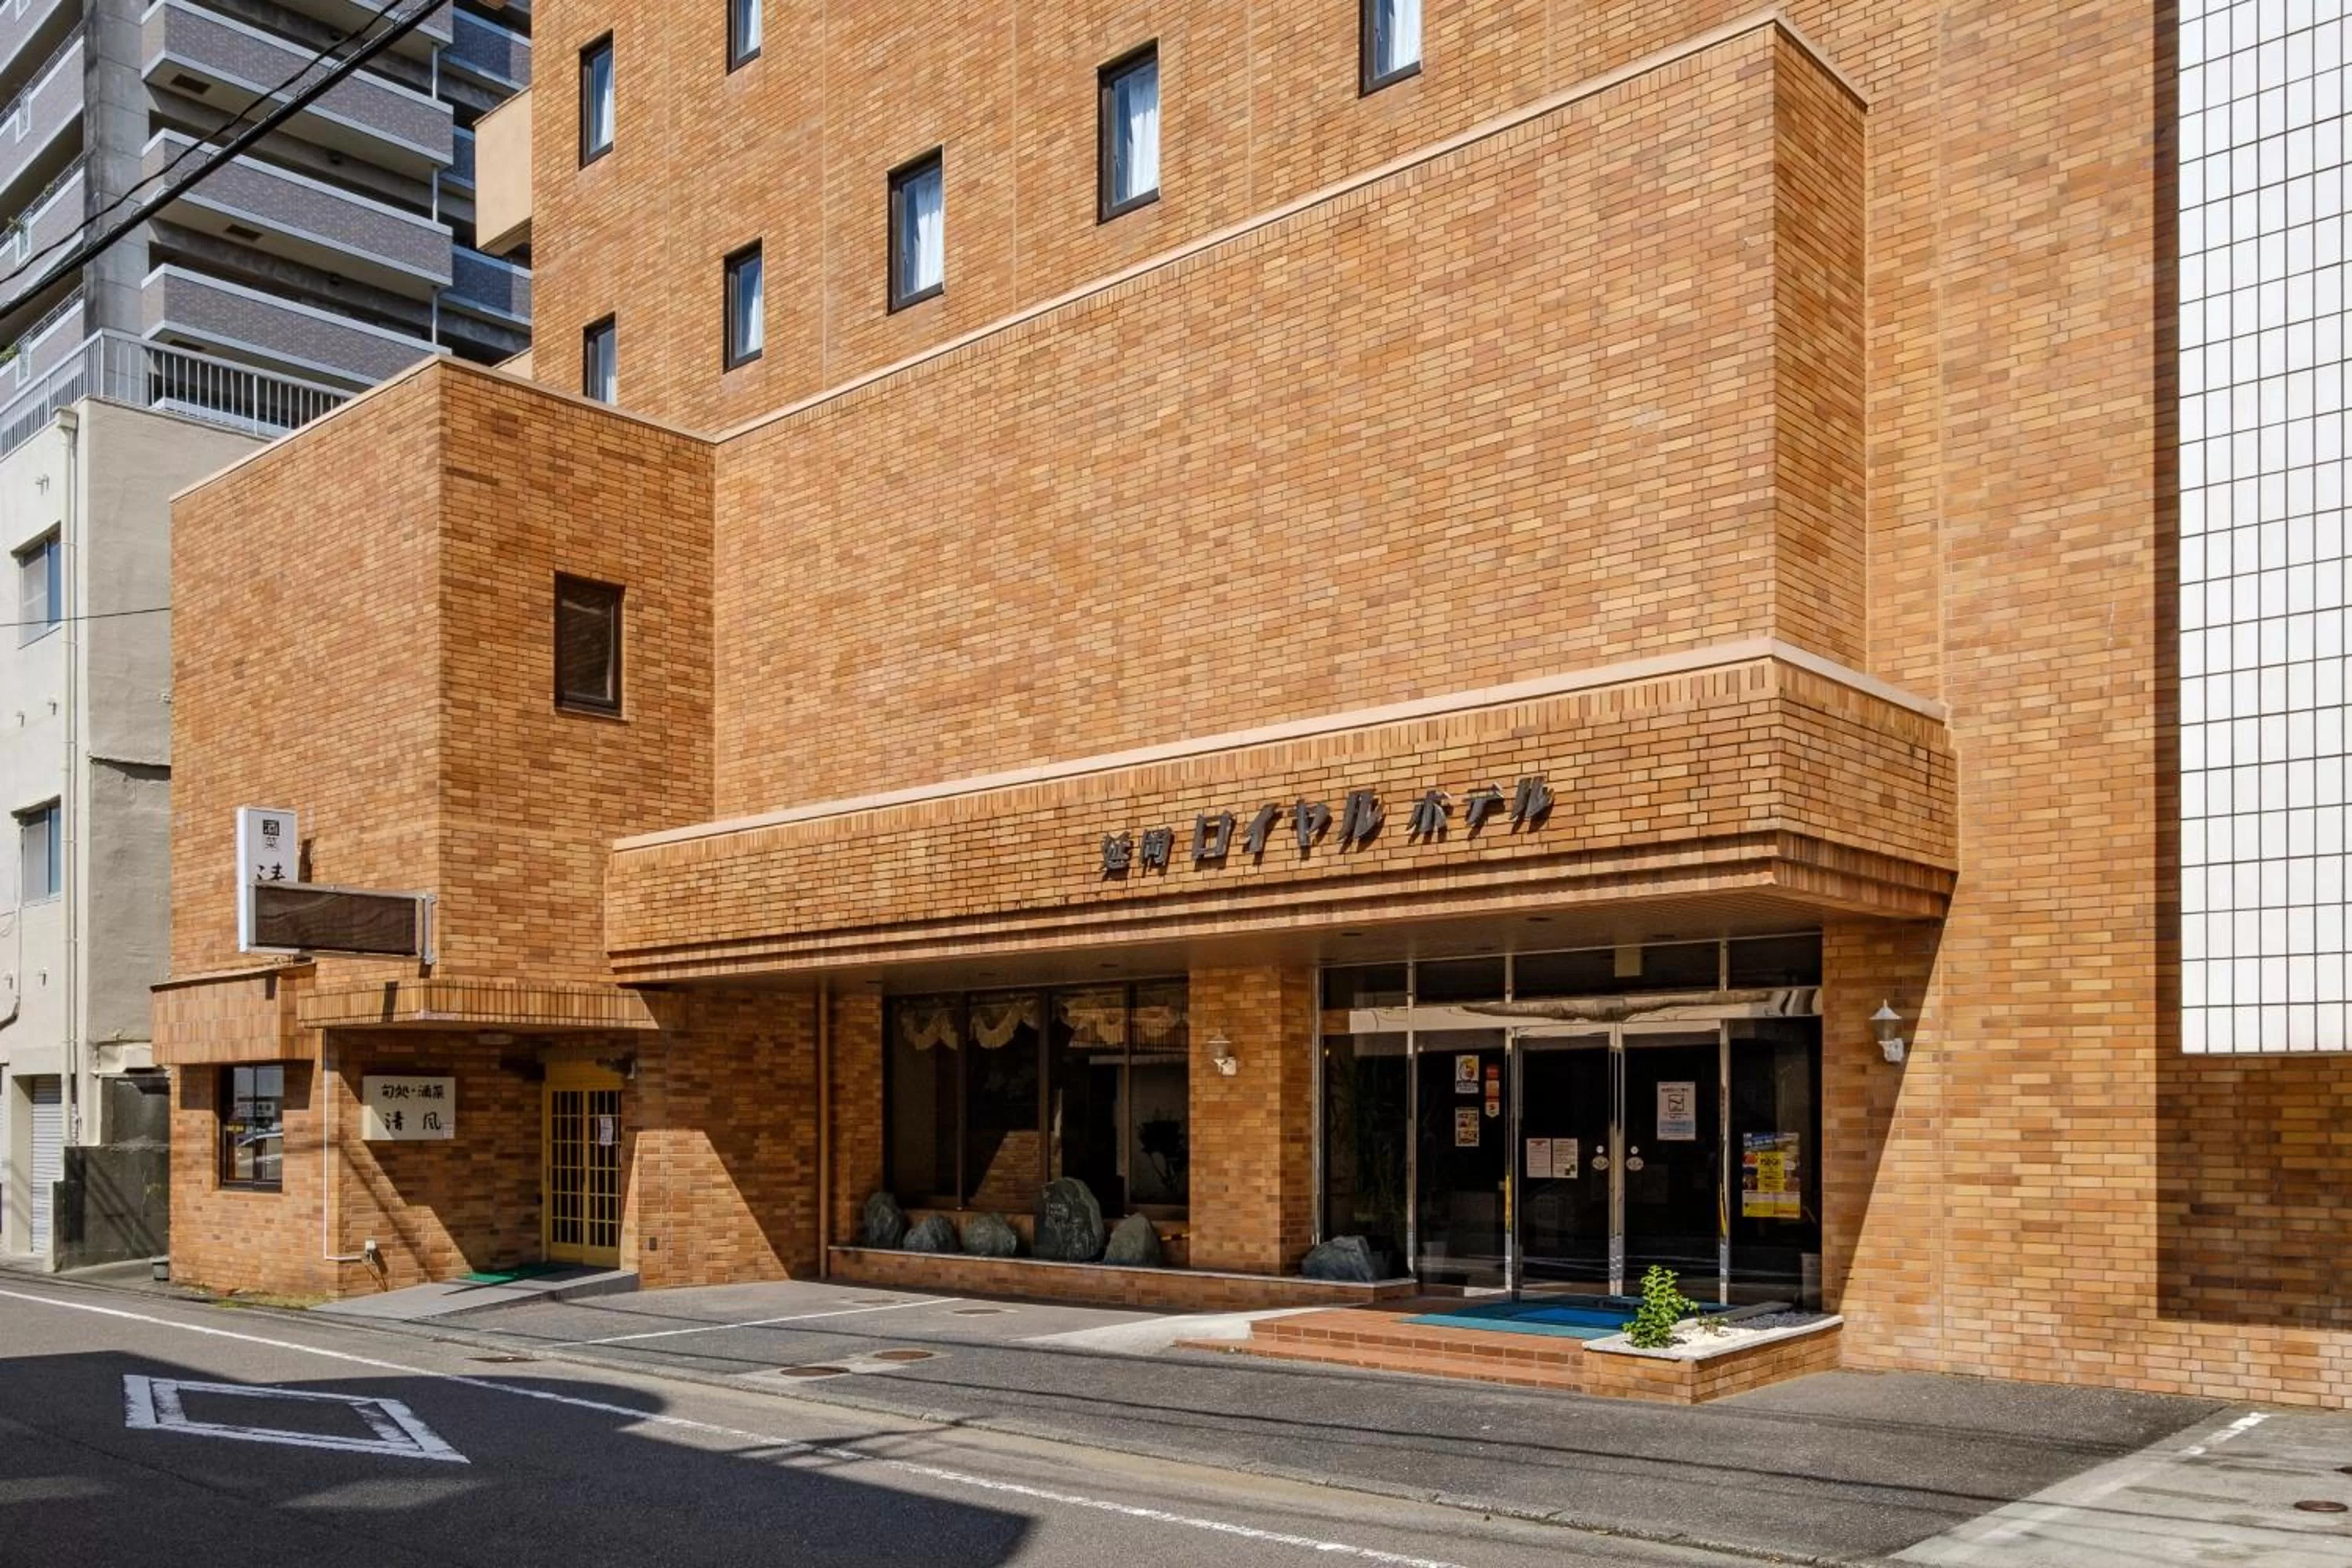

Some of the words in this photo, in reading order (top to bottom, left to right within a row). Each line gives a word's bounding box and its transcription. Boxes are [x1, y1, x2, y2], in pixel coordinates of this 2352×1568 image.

[1191, 789, 1386, 859] ロイヤル
[1406, 776, 1555, 833] ホテル
